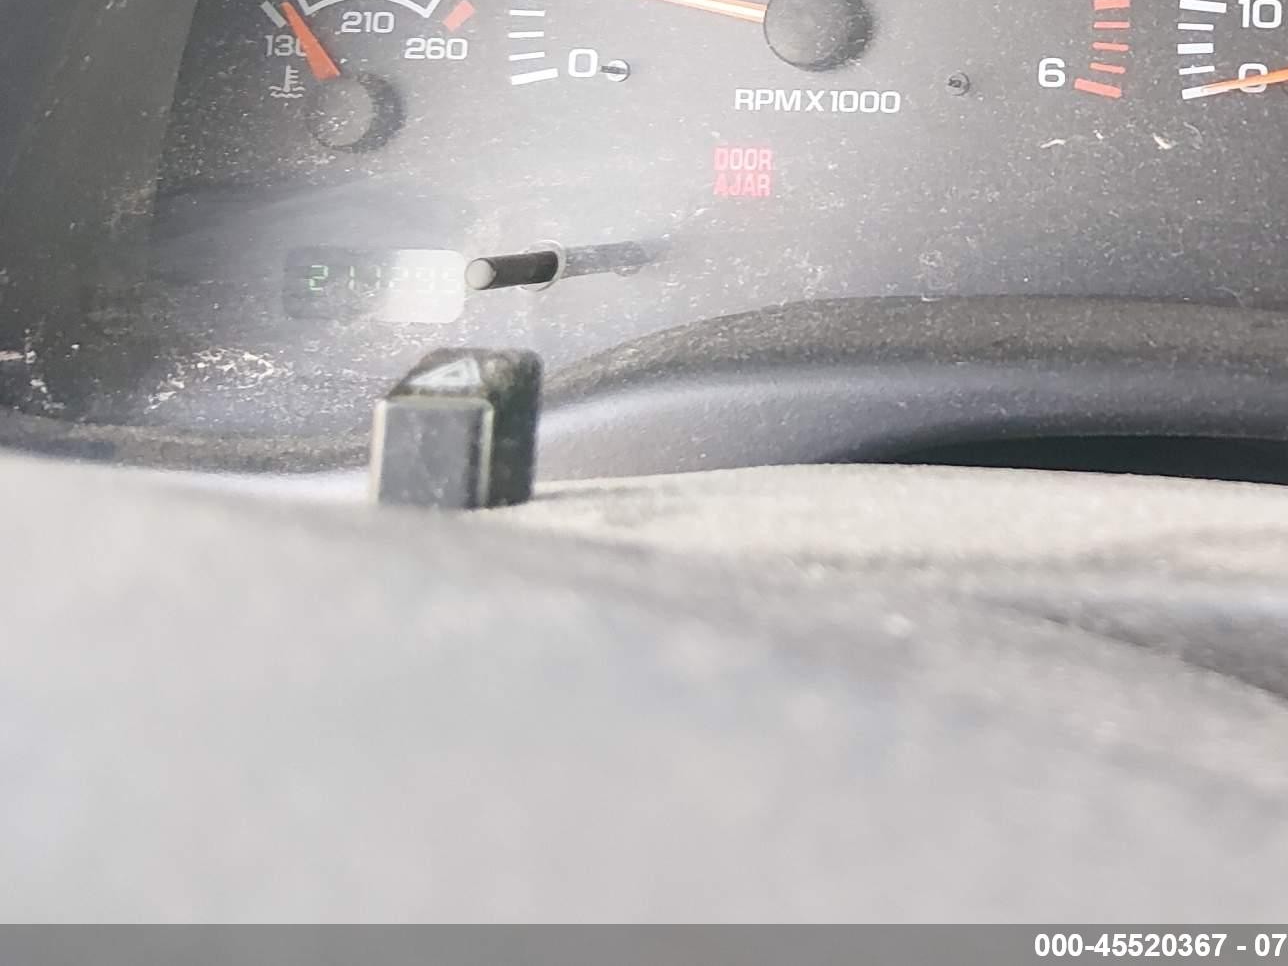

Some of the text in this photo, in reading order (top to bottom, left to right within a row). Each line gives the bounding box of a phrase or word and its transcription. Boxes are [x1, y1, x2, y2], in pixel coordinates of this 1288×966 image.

[341, 11, 395, 34] 210
[404, 37, 469, 60] 260
[567, 48, 599, 78] 0
[1038, 57, 1066, 88] 6
[734, 88, 901, 114] RPM X 1000
[713, 146, 773, 172] DOOR
[713, 172, 772, 197] AJAR
